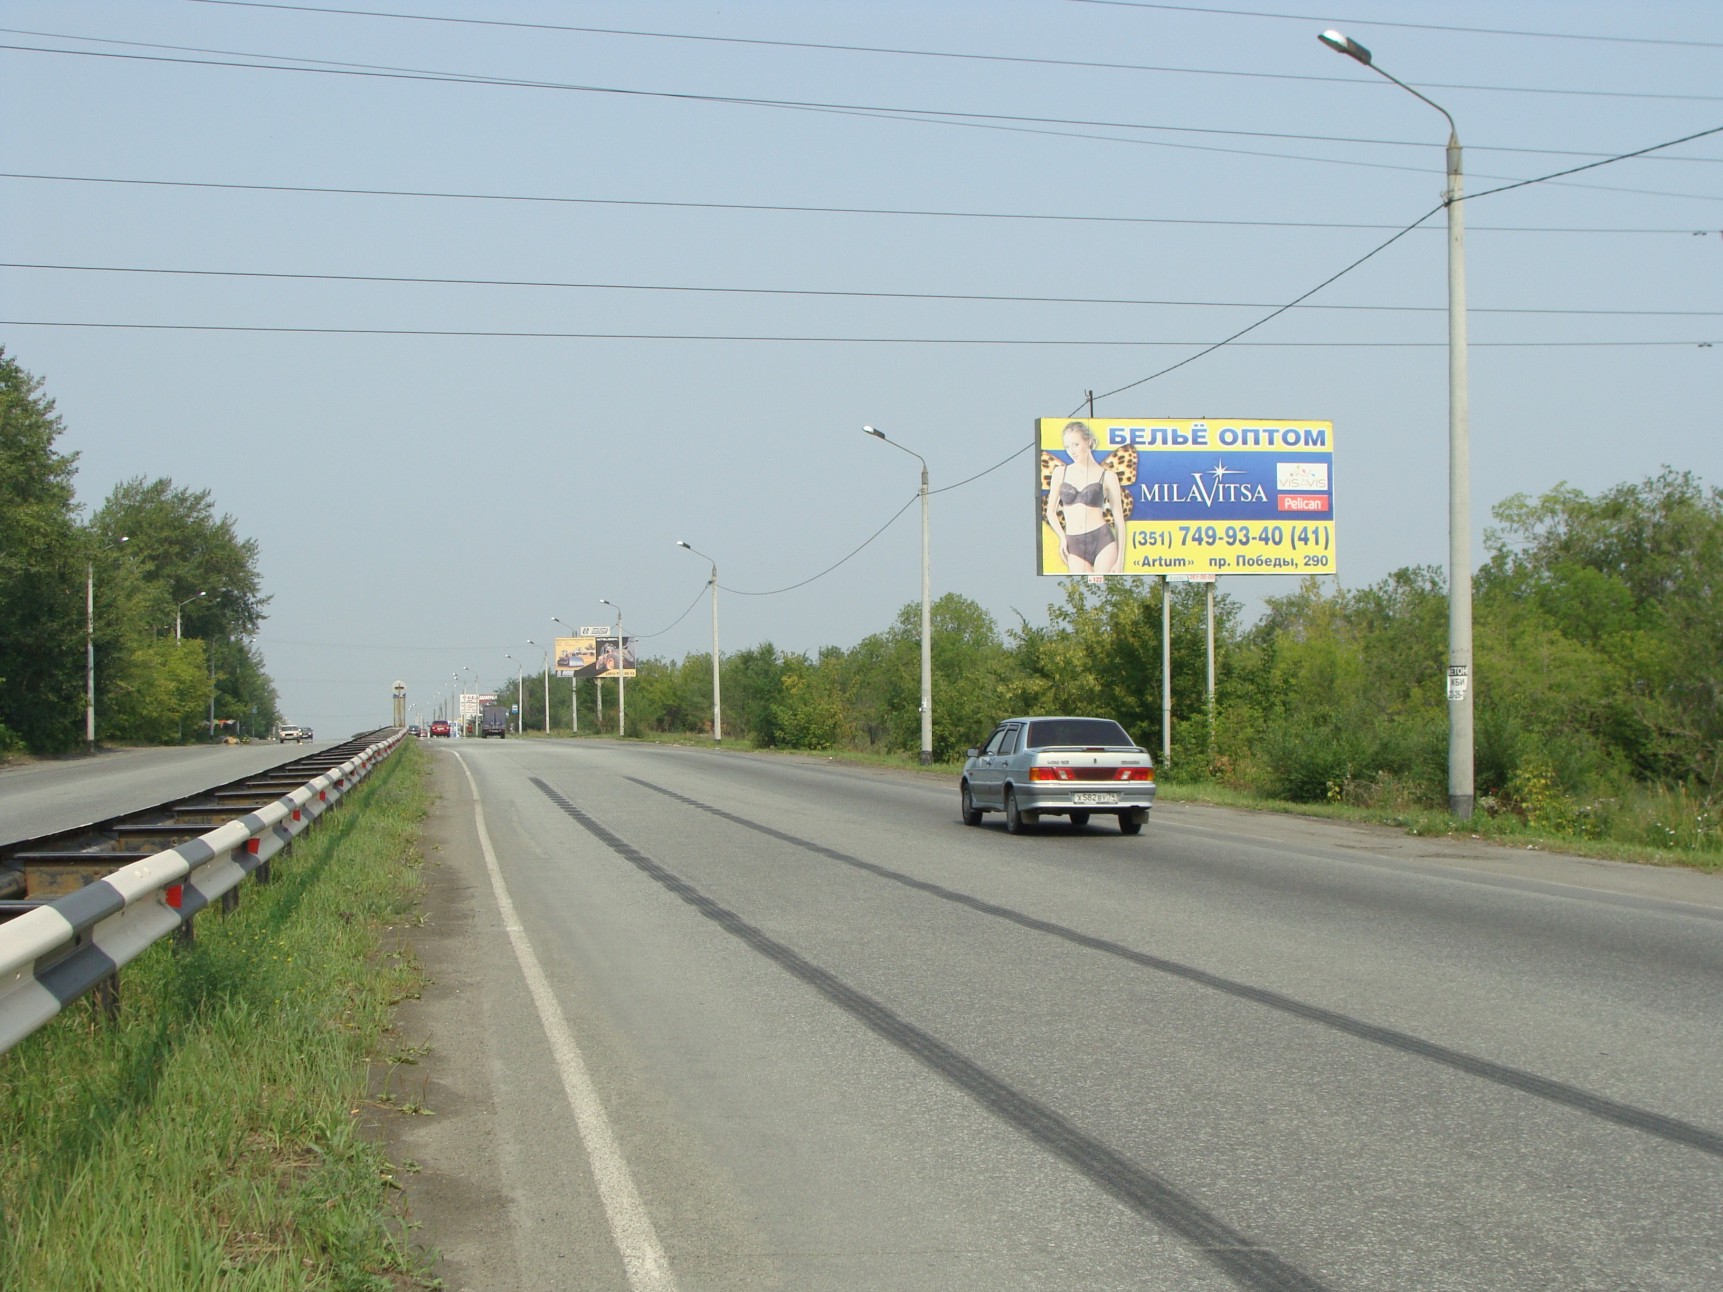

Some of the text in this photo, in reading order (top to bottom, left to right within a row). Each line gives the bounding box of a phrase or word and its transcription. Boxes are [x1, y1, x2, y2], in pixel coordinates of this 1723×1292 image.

[1109, 424, 1326, 447] БЕЛЬЁ ОПТОМ
[1140, 473, 1268, 508] MILAVITSA
[1284, 497, 1322, 510] Pelican
[1132, 525, 1330, 550] (351) 749-93-40 (41)
[1133, 554, 1329, 569] «Artum» пр. Победы, 290
